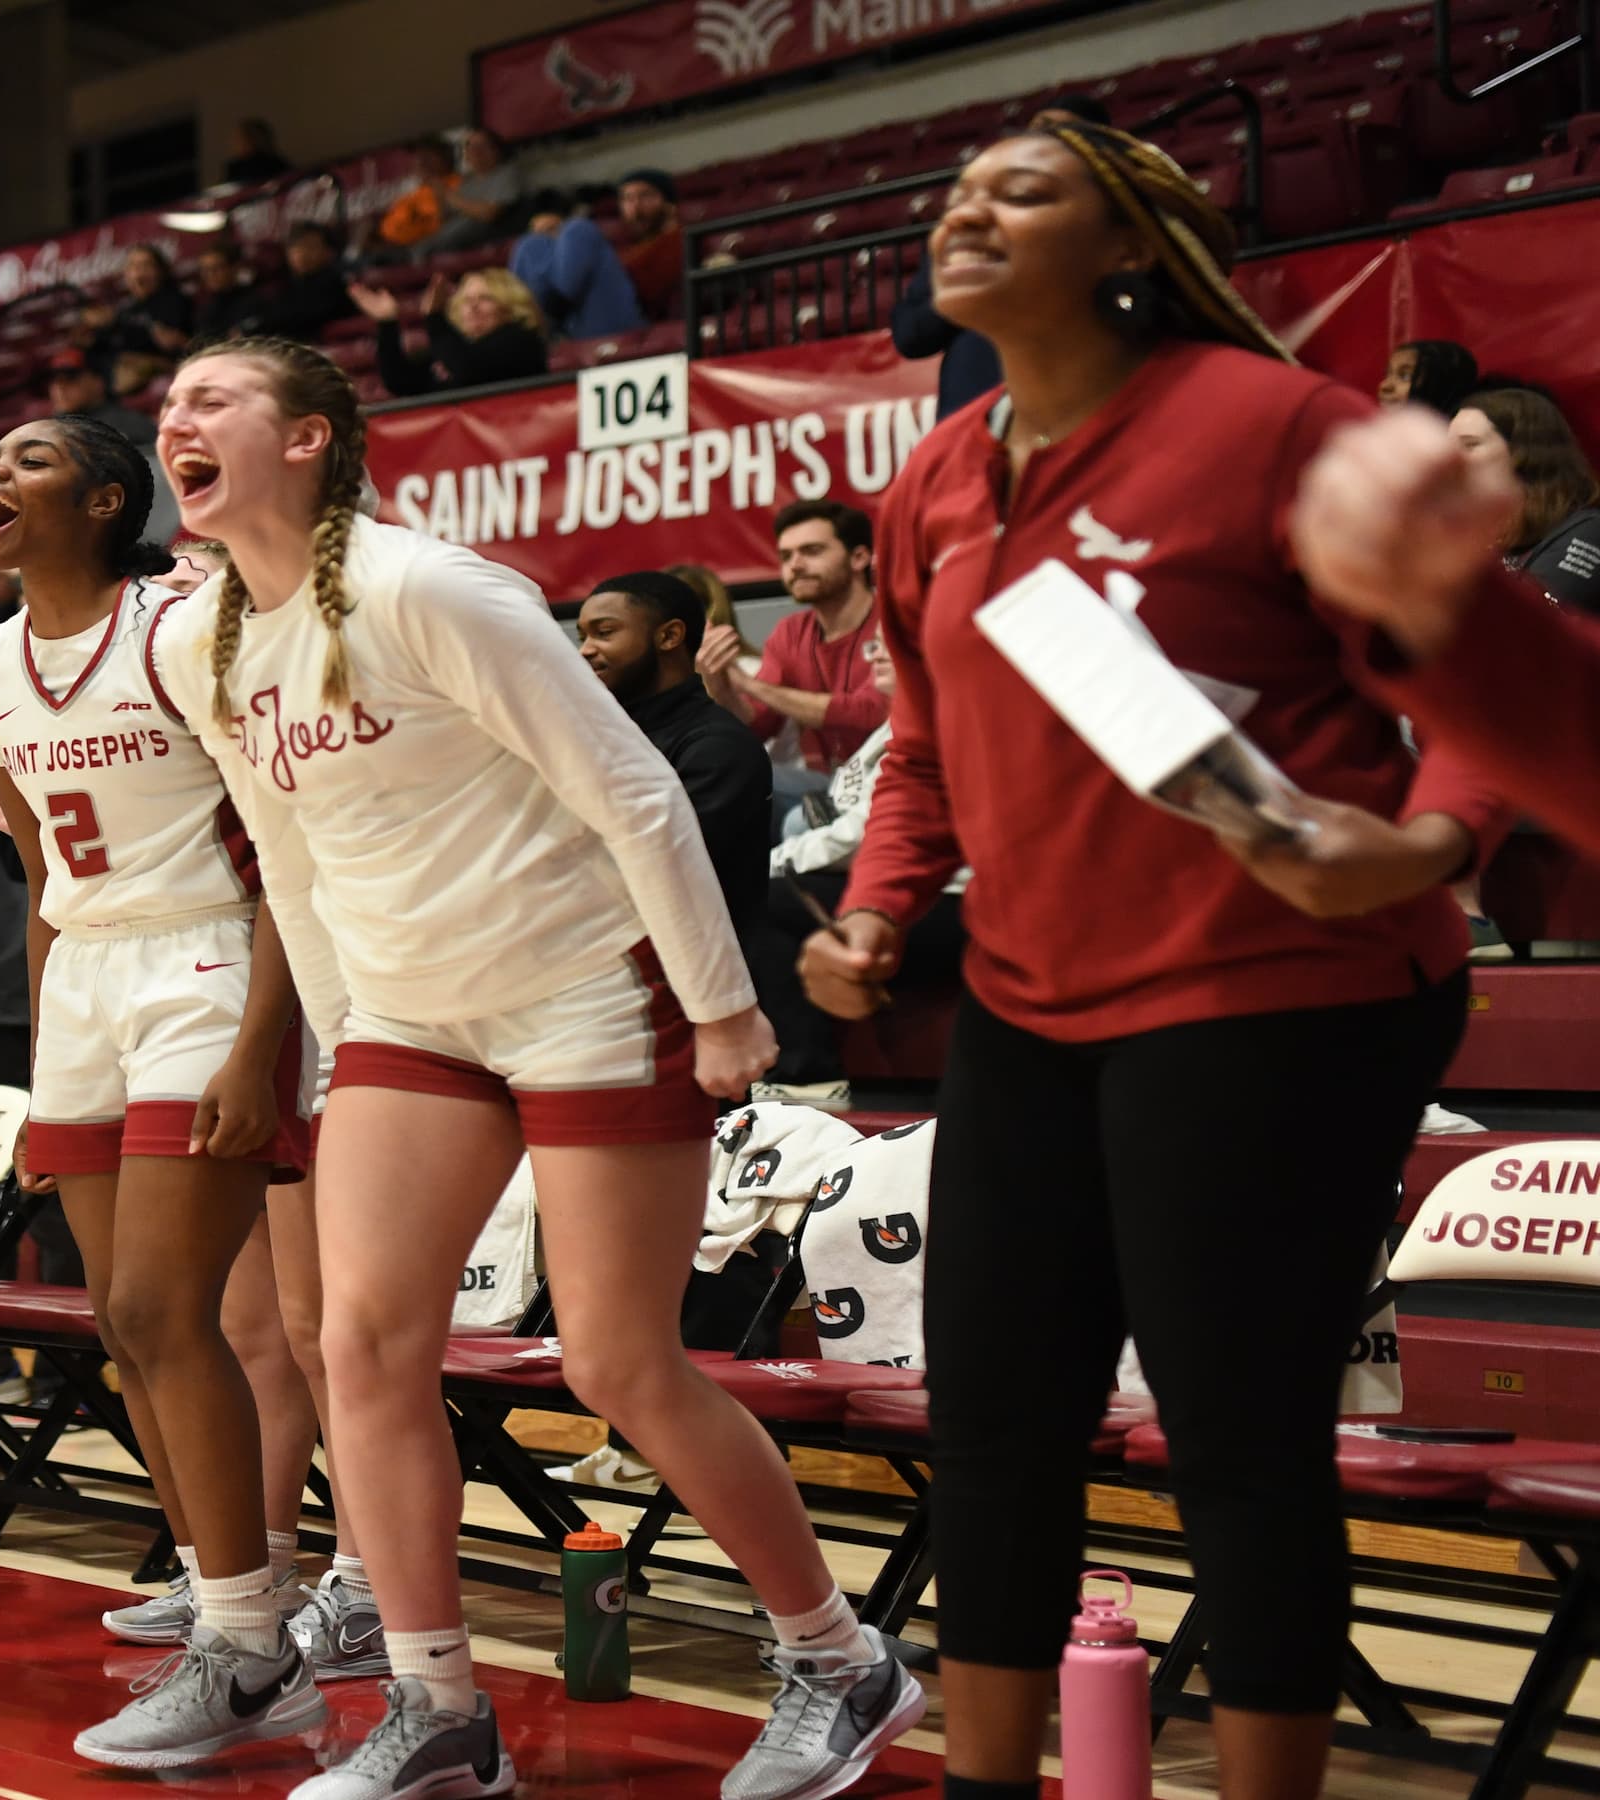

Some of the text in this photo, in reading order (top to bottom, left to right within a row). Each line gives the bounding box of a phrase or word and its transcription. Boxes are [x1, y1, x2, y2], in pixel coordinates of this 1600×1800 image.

[593, 374, 672, 430] 104
[397, 455, 548, 547] SAINT
[556, 411, 832, 536] JOSEPH'S
[2, 729, 170, 777] AINT JOSEPH'S
[250, 684, 395, 793] Joes
[44, 788, 114, 880] 2
[1490, 1158, 1600, 1196] SAIN
[1495, 1375, 1513, 1390] 10
